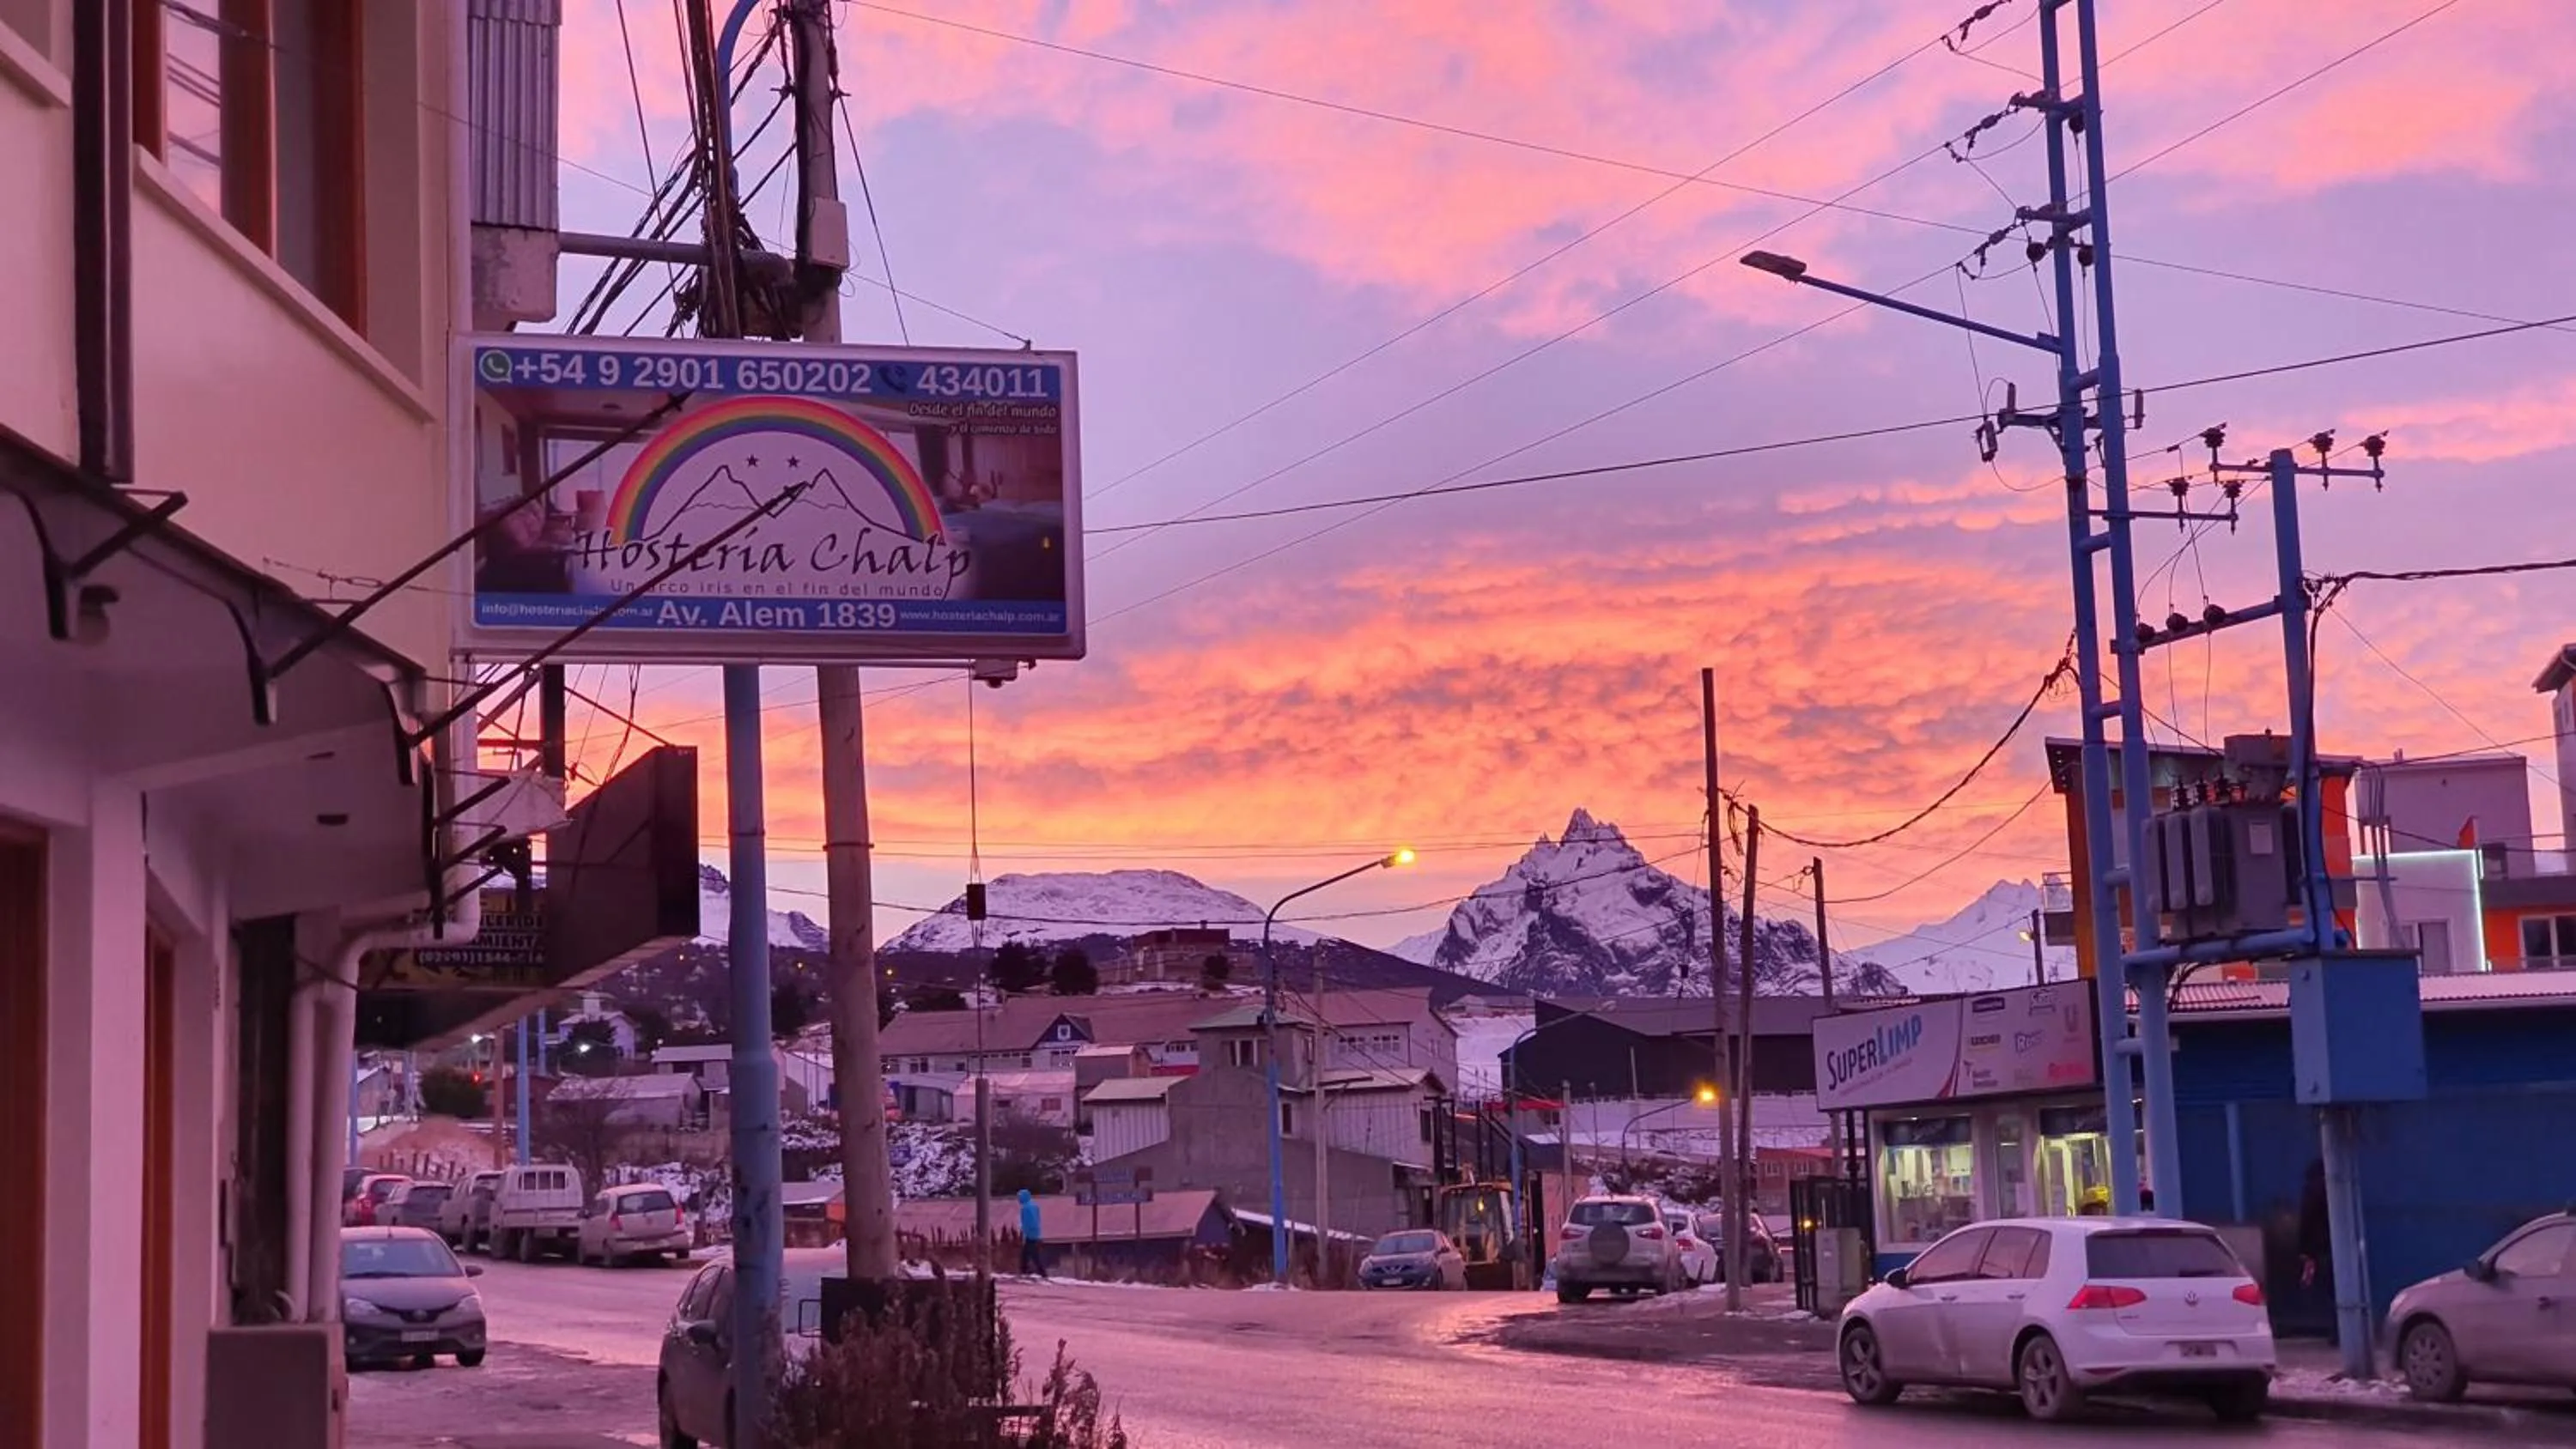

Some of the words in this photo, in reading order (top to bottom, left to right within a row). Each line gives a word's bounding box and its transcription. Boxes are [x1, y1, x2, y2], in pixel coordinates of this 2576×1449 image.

[515, 353, 587, 385] +54
[598, 355, 621, 386] 9
[633, 356, 725, 389] 2901
[737, 360, 872, 393] 650202
[916, 365, 1048, 397] 434011
[909, 403, 947, 416] Desde
[951, 403, 963, 415] el
[967, 403, 984, 417] fin
[987, 404, 1007, 417] del
[1011, 405, 1057, 418] mundo
[564, 525, 796, 574] Hostería
[810, 526, 970, 600] Chalp
[610, 579, 635, 593] Un
[700, 580, 733, 595] iris
[743, 584, 766, 595] en
[775, 581, 793, 595] el
[803, 581, 829, 596] fin
[839, 582, 868, 596] del
[878, 583, 945, 597] mundo
[656, 599, 708, 627] Av.
[718, 600, 805, 627] Alem
[817, 602, 896, 628] 1839
